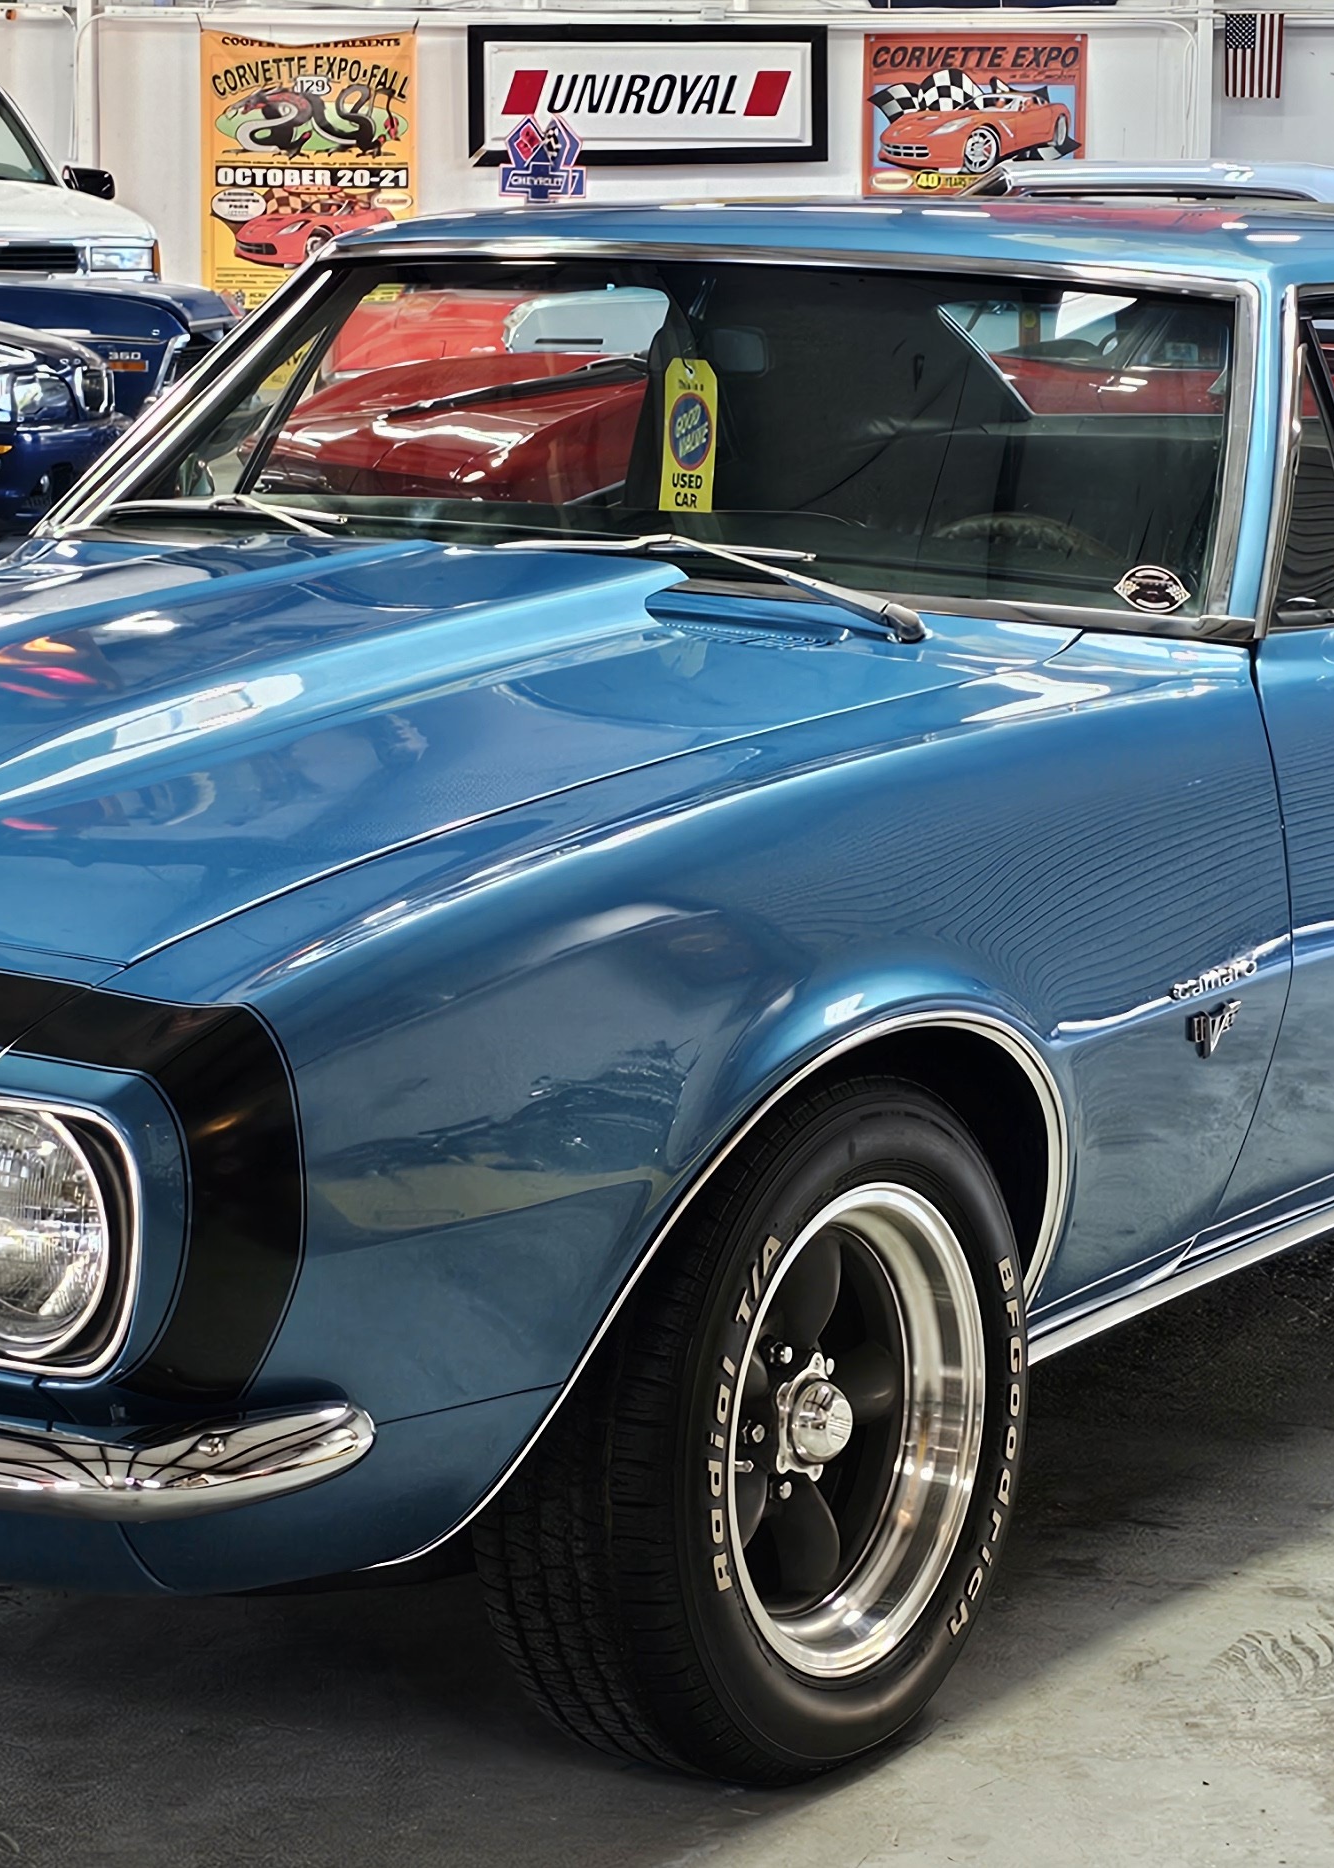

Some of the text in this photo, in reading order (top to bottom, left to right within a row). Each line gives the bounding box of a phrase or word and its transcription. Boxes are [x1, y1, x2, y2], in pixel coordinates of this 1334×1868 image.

[873, 46, 1079, 69] CORVETTE EXPO
[212, 55, 307, 97] CORVETTE
[299, 79, 326, 92] 129
[547, 73, 738, 114] UNIROYAL
[217, 167, 408, 187] OCTOBER 20-21
[917, 173, 939, 187] 40
[672, 472, 703, 489] USED
[675, 491, 698, 509] CAR
[1172, 959, 1257, 1000] Camaro
[708, 1235, 782, 1592] Radial T/A
[947, 1256, 1023, 1636] BFGoodrich
